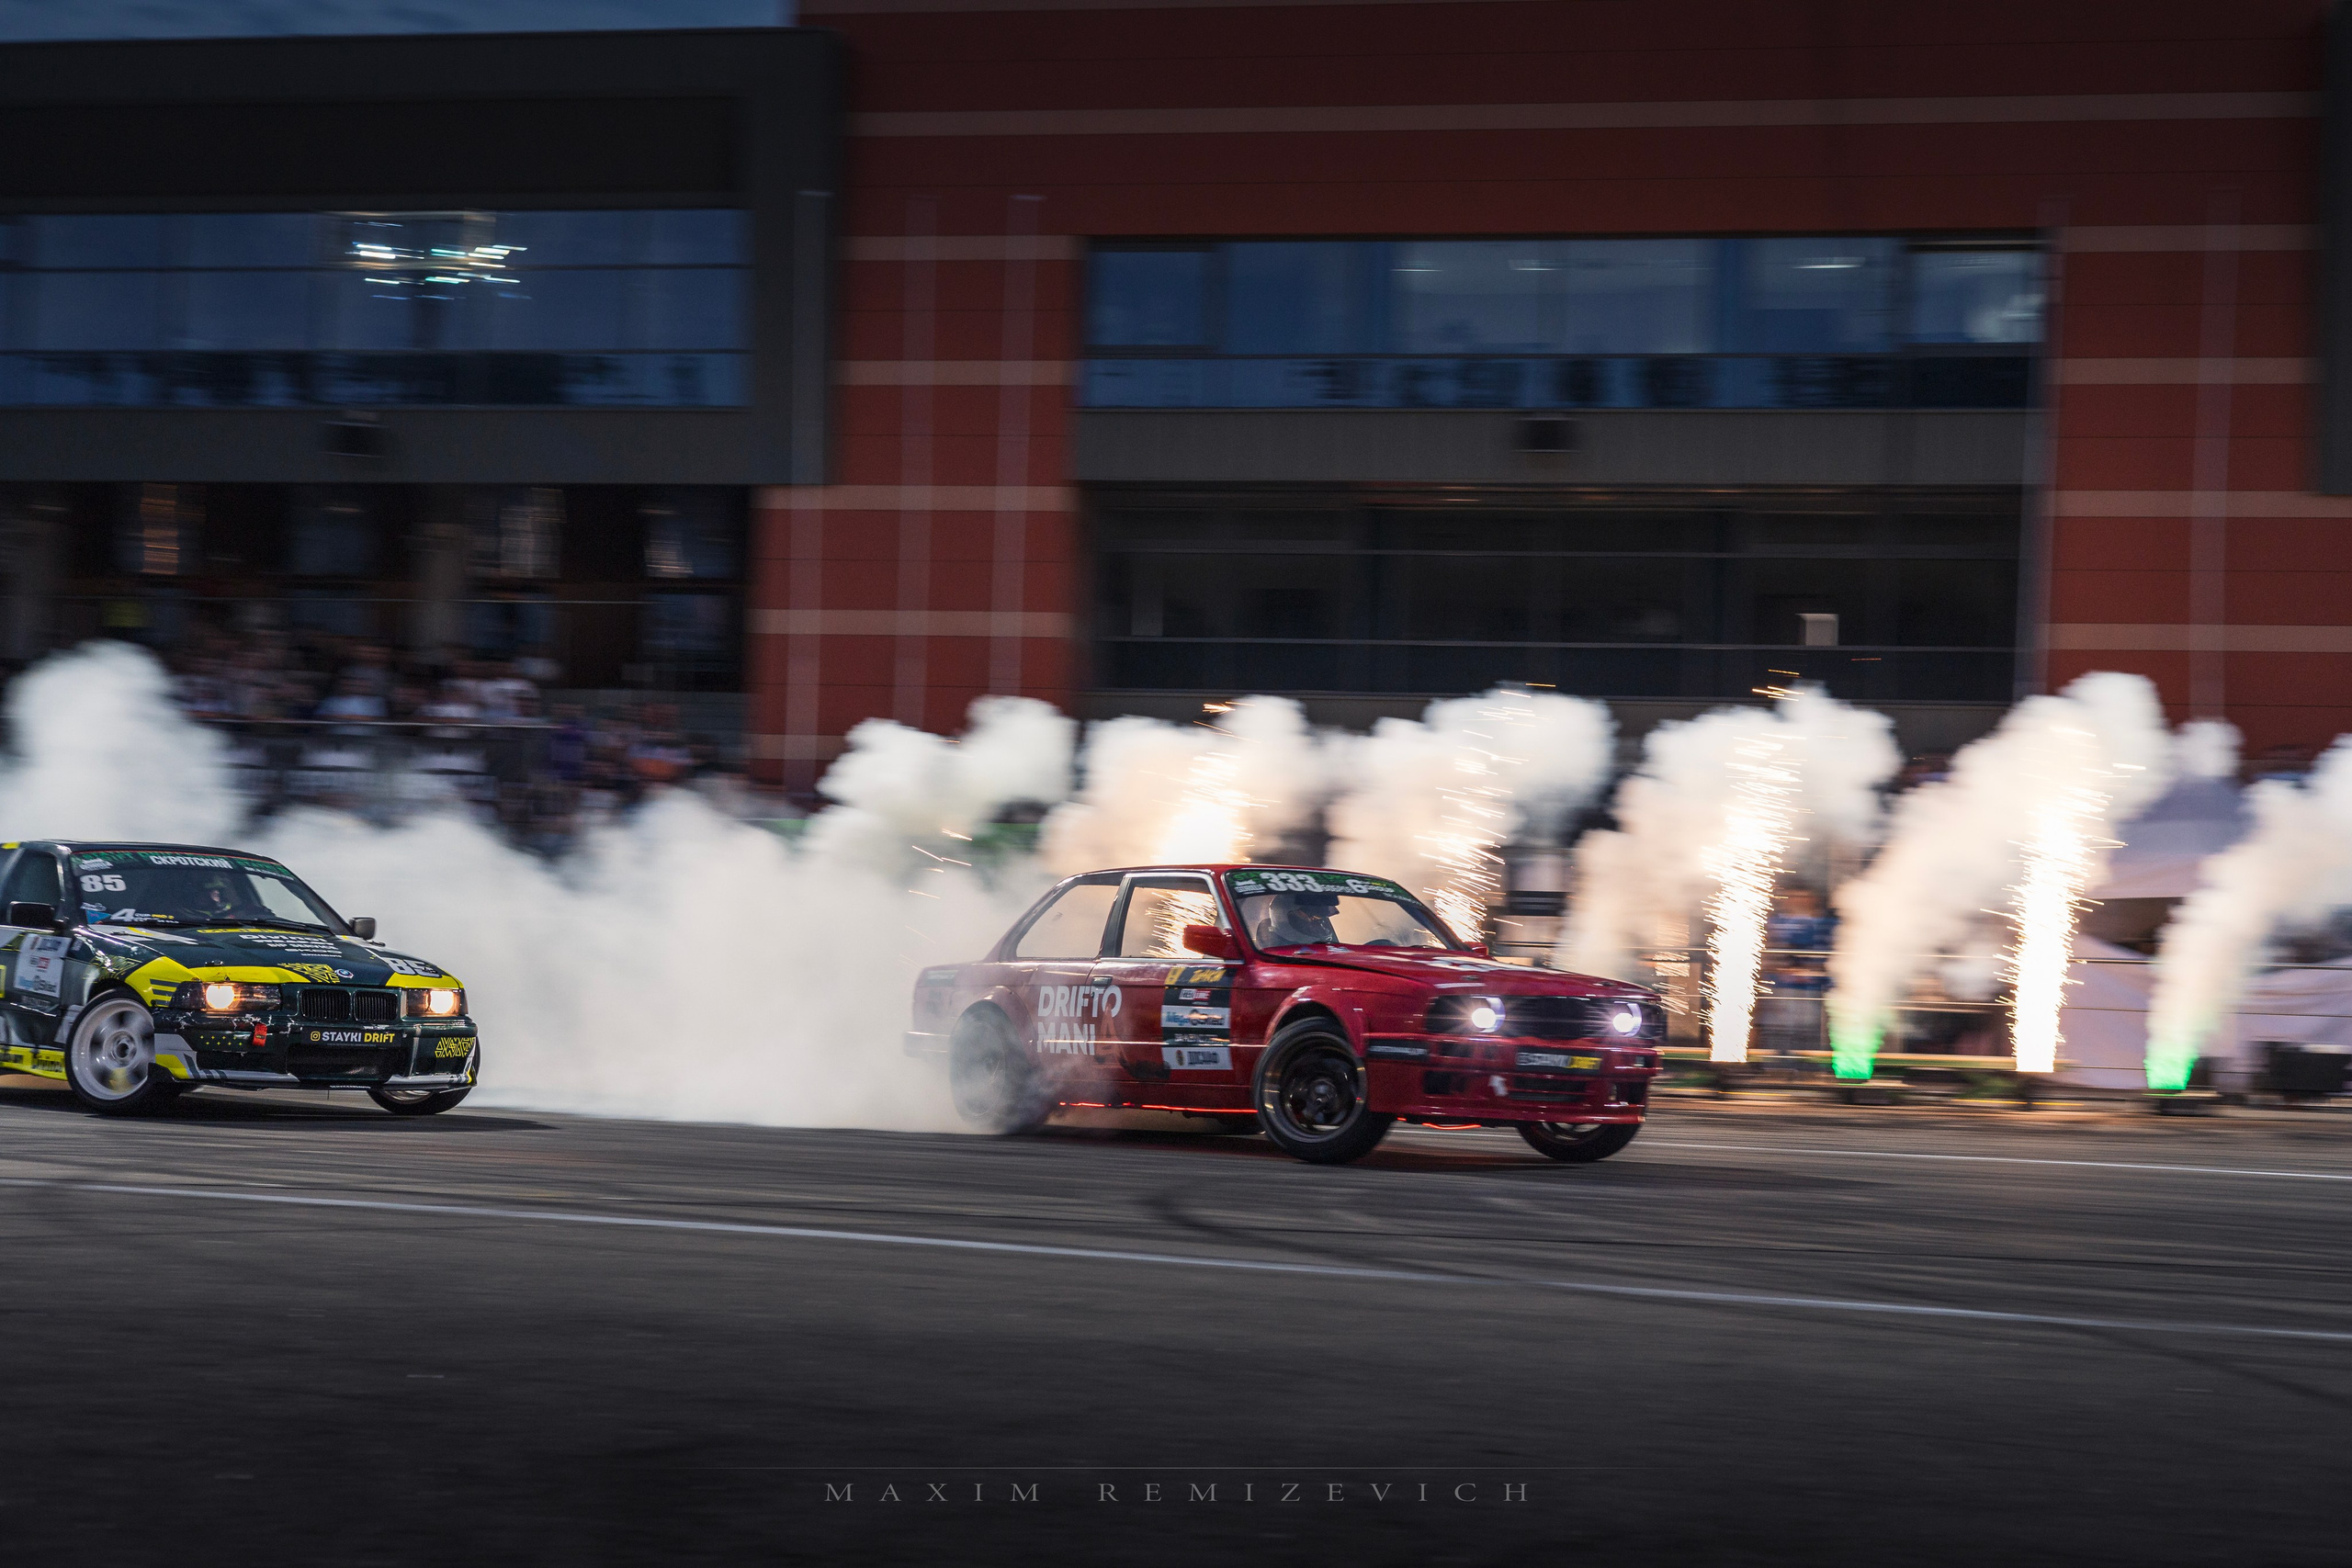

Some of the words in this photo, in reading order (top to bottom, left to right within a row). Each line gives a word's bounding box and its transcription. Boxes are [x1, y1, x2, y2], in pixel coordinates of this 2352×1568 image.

[150, 856, 233, 870] СКРОТСКИЙ
[80, 874, 126, 893] 85
[1259, 873, 1324, 894] 333
[385, 957, 441, 977] 85
[322, 1031, 362, 1043] STAYKI
[363, 1032, 395, 1043] DRIFT
